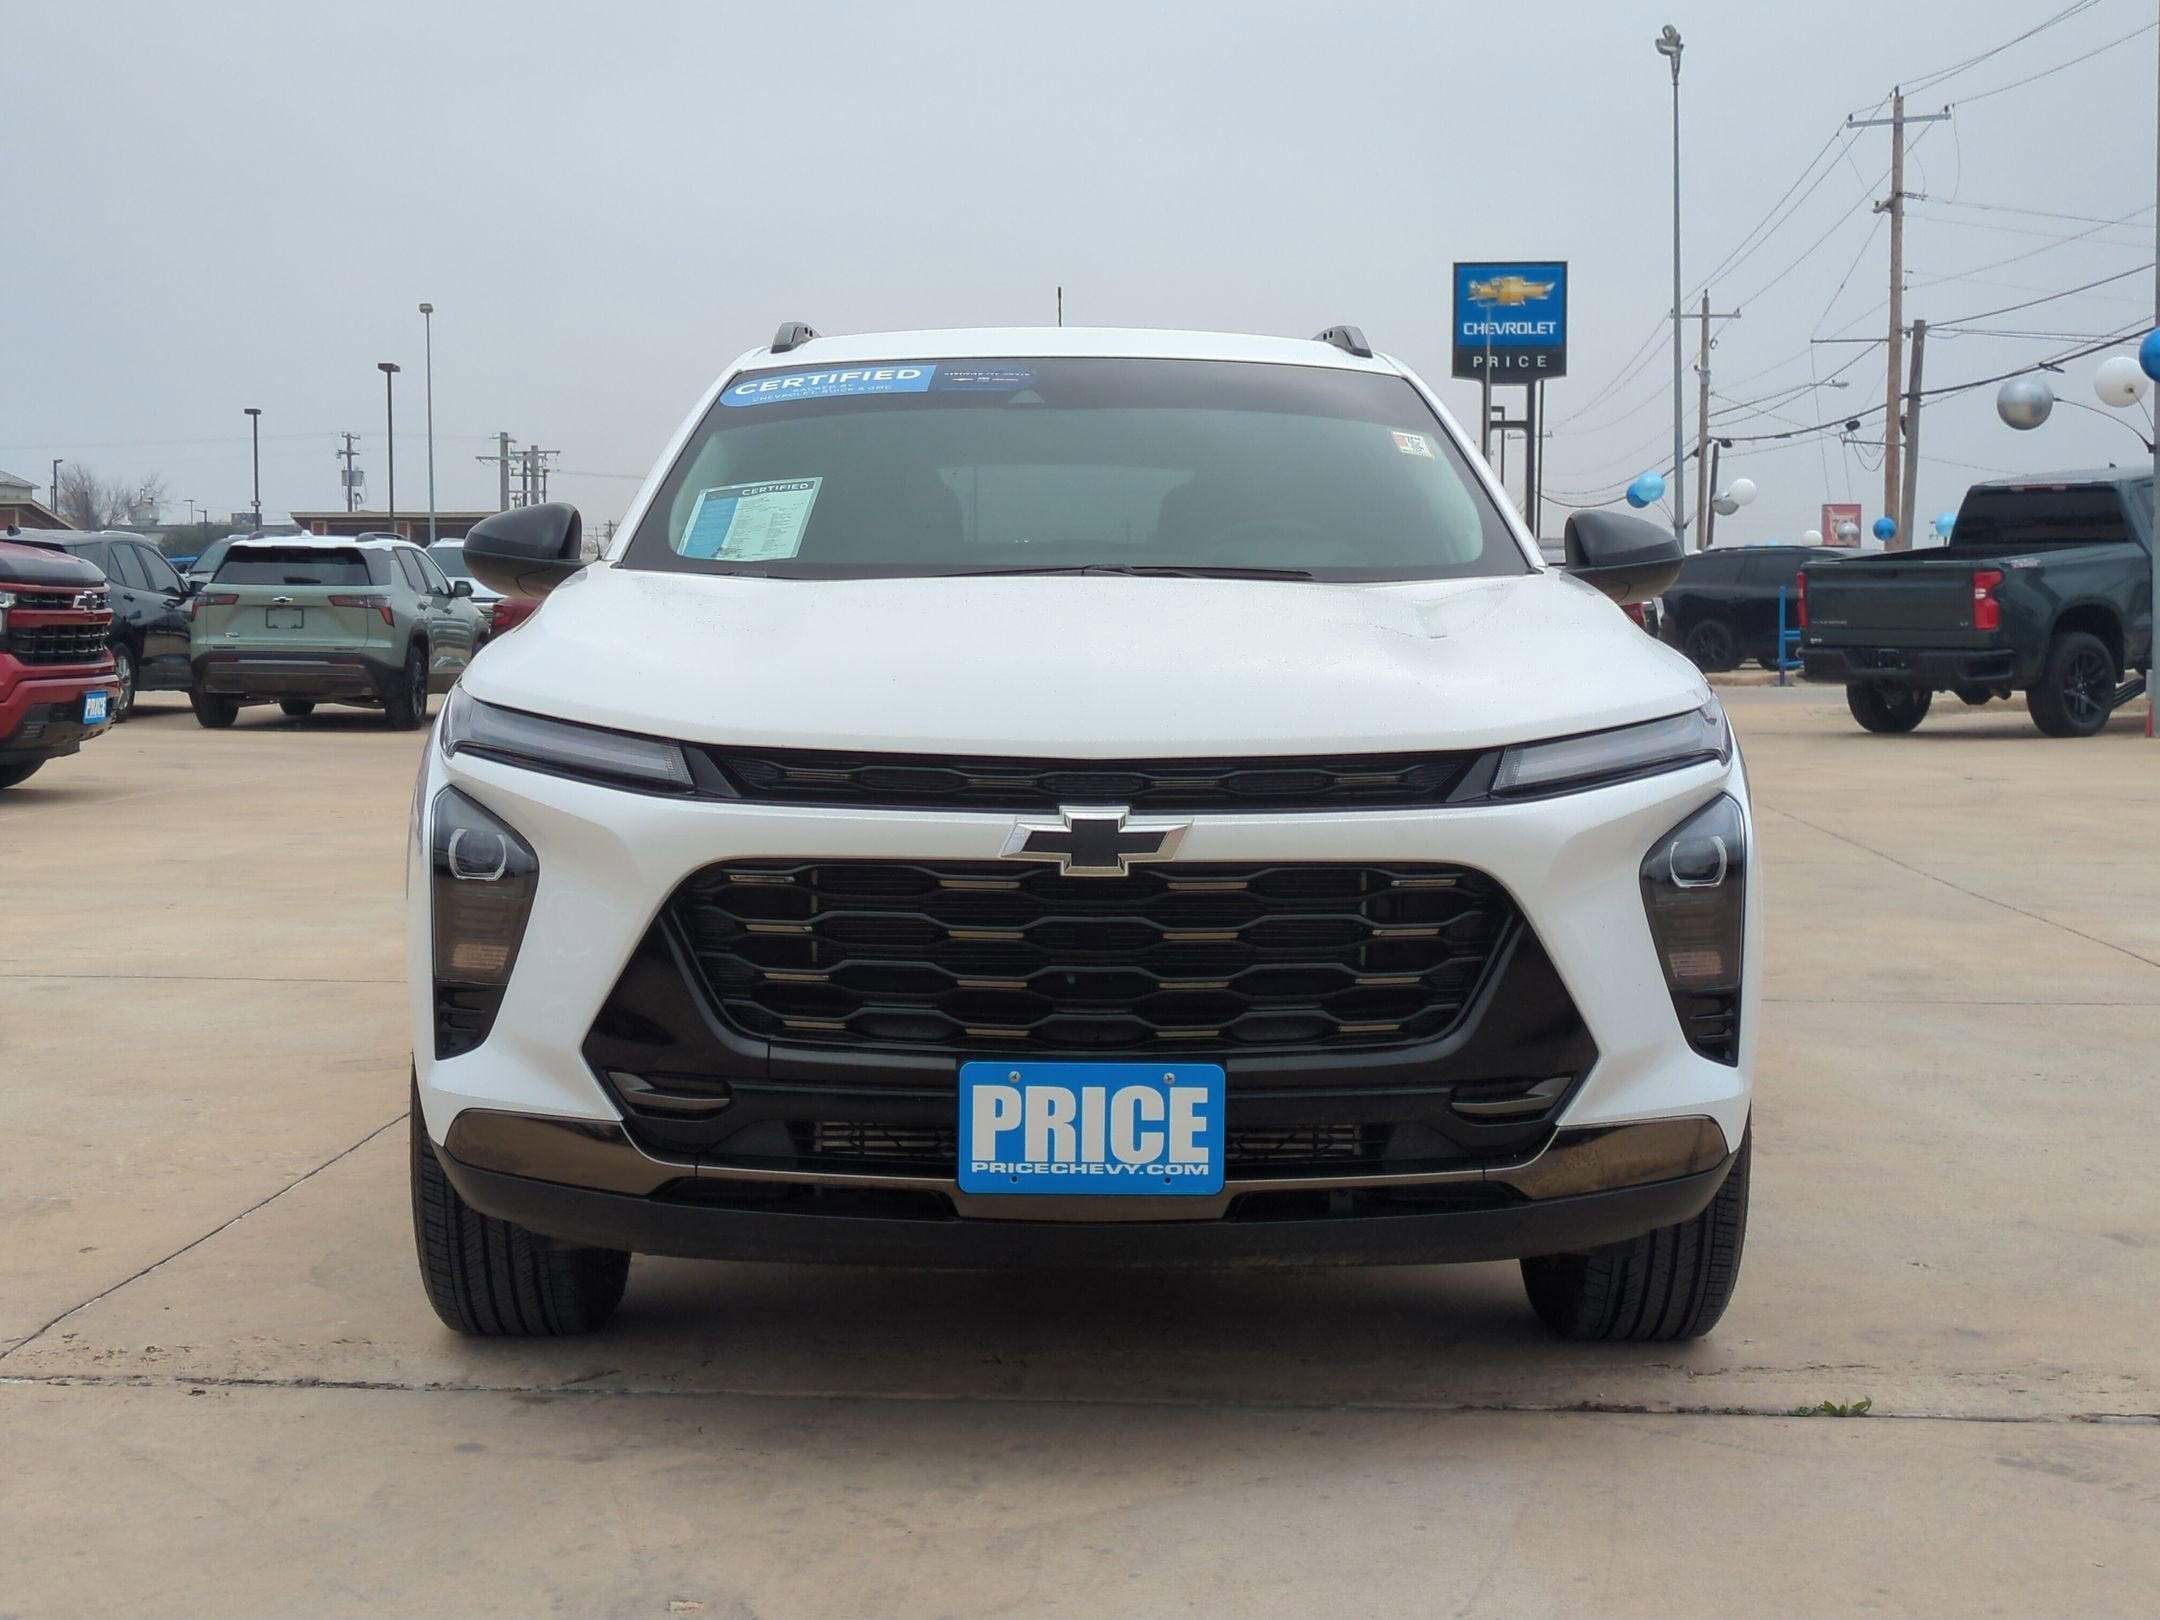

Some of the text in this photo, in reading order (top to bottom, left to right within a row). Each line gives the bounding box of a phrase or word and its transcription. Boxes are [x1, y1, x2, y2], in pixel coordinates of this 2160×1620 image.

[1463, 321, 1557, 335] CHEVROLET
[1473, 355, 1547, 368] PRICE
[735, 369, 921, 395] CERTIFIED
[742, 482, 809, 496] CERTIFIED
[972, 1085, 1209, 1164] PRICE
[971, 1162, 1209, 1175] PRICECHEVY.COM
